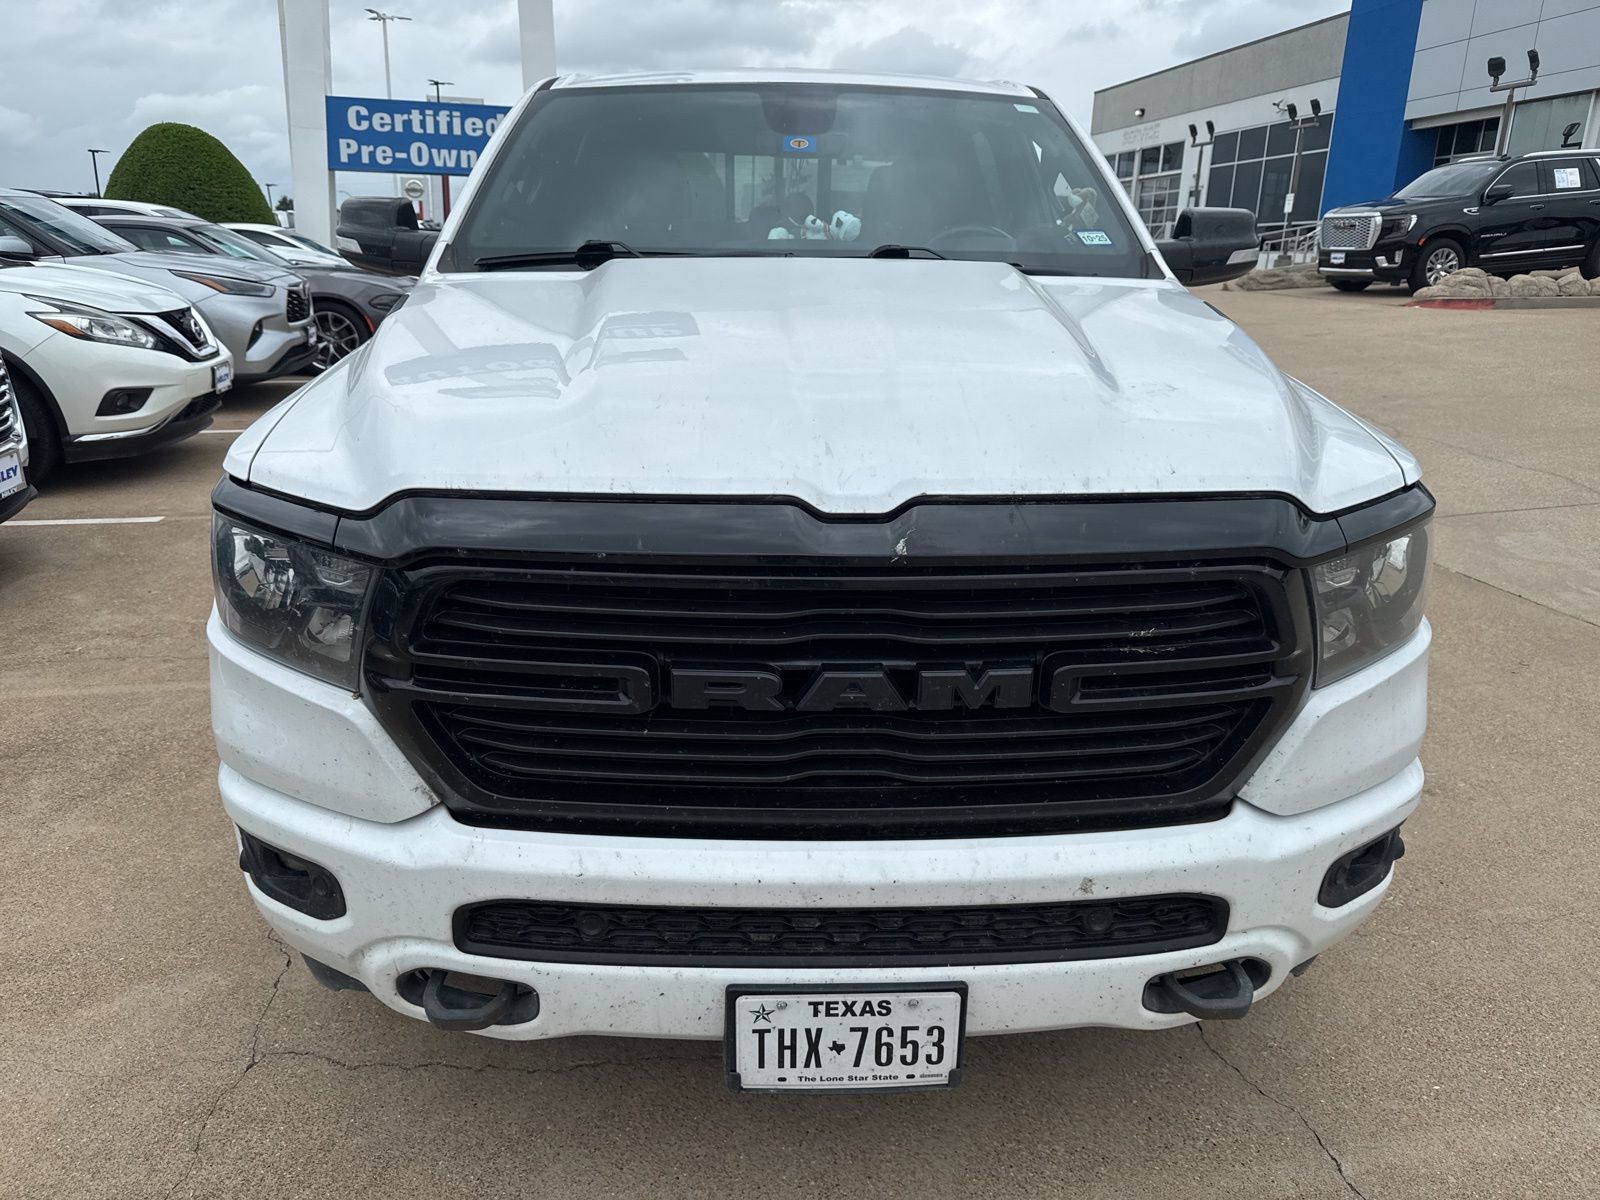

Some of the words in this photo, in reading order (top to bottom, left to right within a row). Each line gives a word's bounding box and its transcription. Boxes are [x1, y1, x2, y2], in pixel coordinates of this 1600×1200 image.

[347, 105, 504, 137] Certified
[338, 138, 478, 169] Pre-Own
[0, 465, 18, 483] LEY
[670, 667, 1034, 711] RAM
[808, 1000, 892, 1017] TEXAS
[752, 1028, 823, 1069] THX
[849, 1026, 945, 1068] 7653
[847, 1074, 868, 1082] Star
